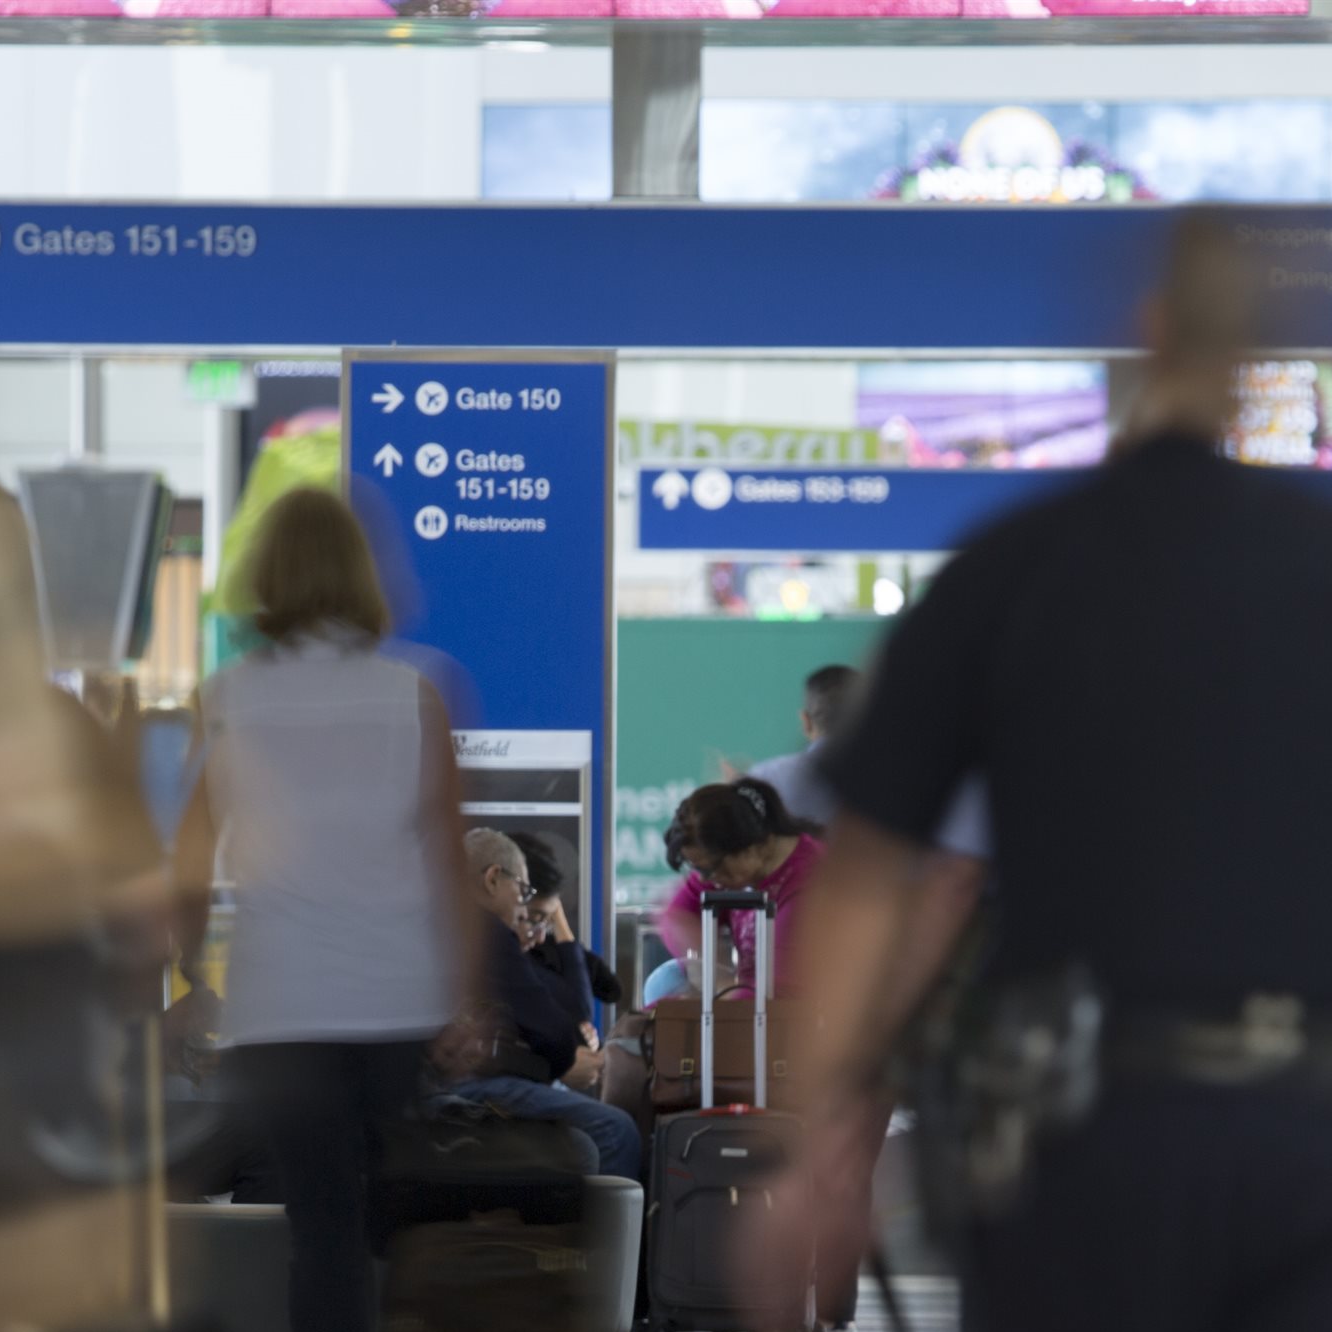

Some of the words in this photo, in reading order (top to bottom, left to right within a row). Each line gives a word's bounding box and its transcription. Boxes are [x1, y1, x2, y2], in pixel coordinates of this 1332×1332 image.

[13, 223, 115, 256] Gates
[123, 225, 258, 257] 151-159
[454, 387, 513, 411] Gate
[518, 388, 562, 411] 150
[454, 448, 526, 472] Gates
[455, 477, 551, 501] 151-159
[734, 475, 803, 503] Gates
[454, 513, 547, 532] Restrooms
